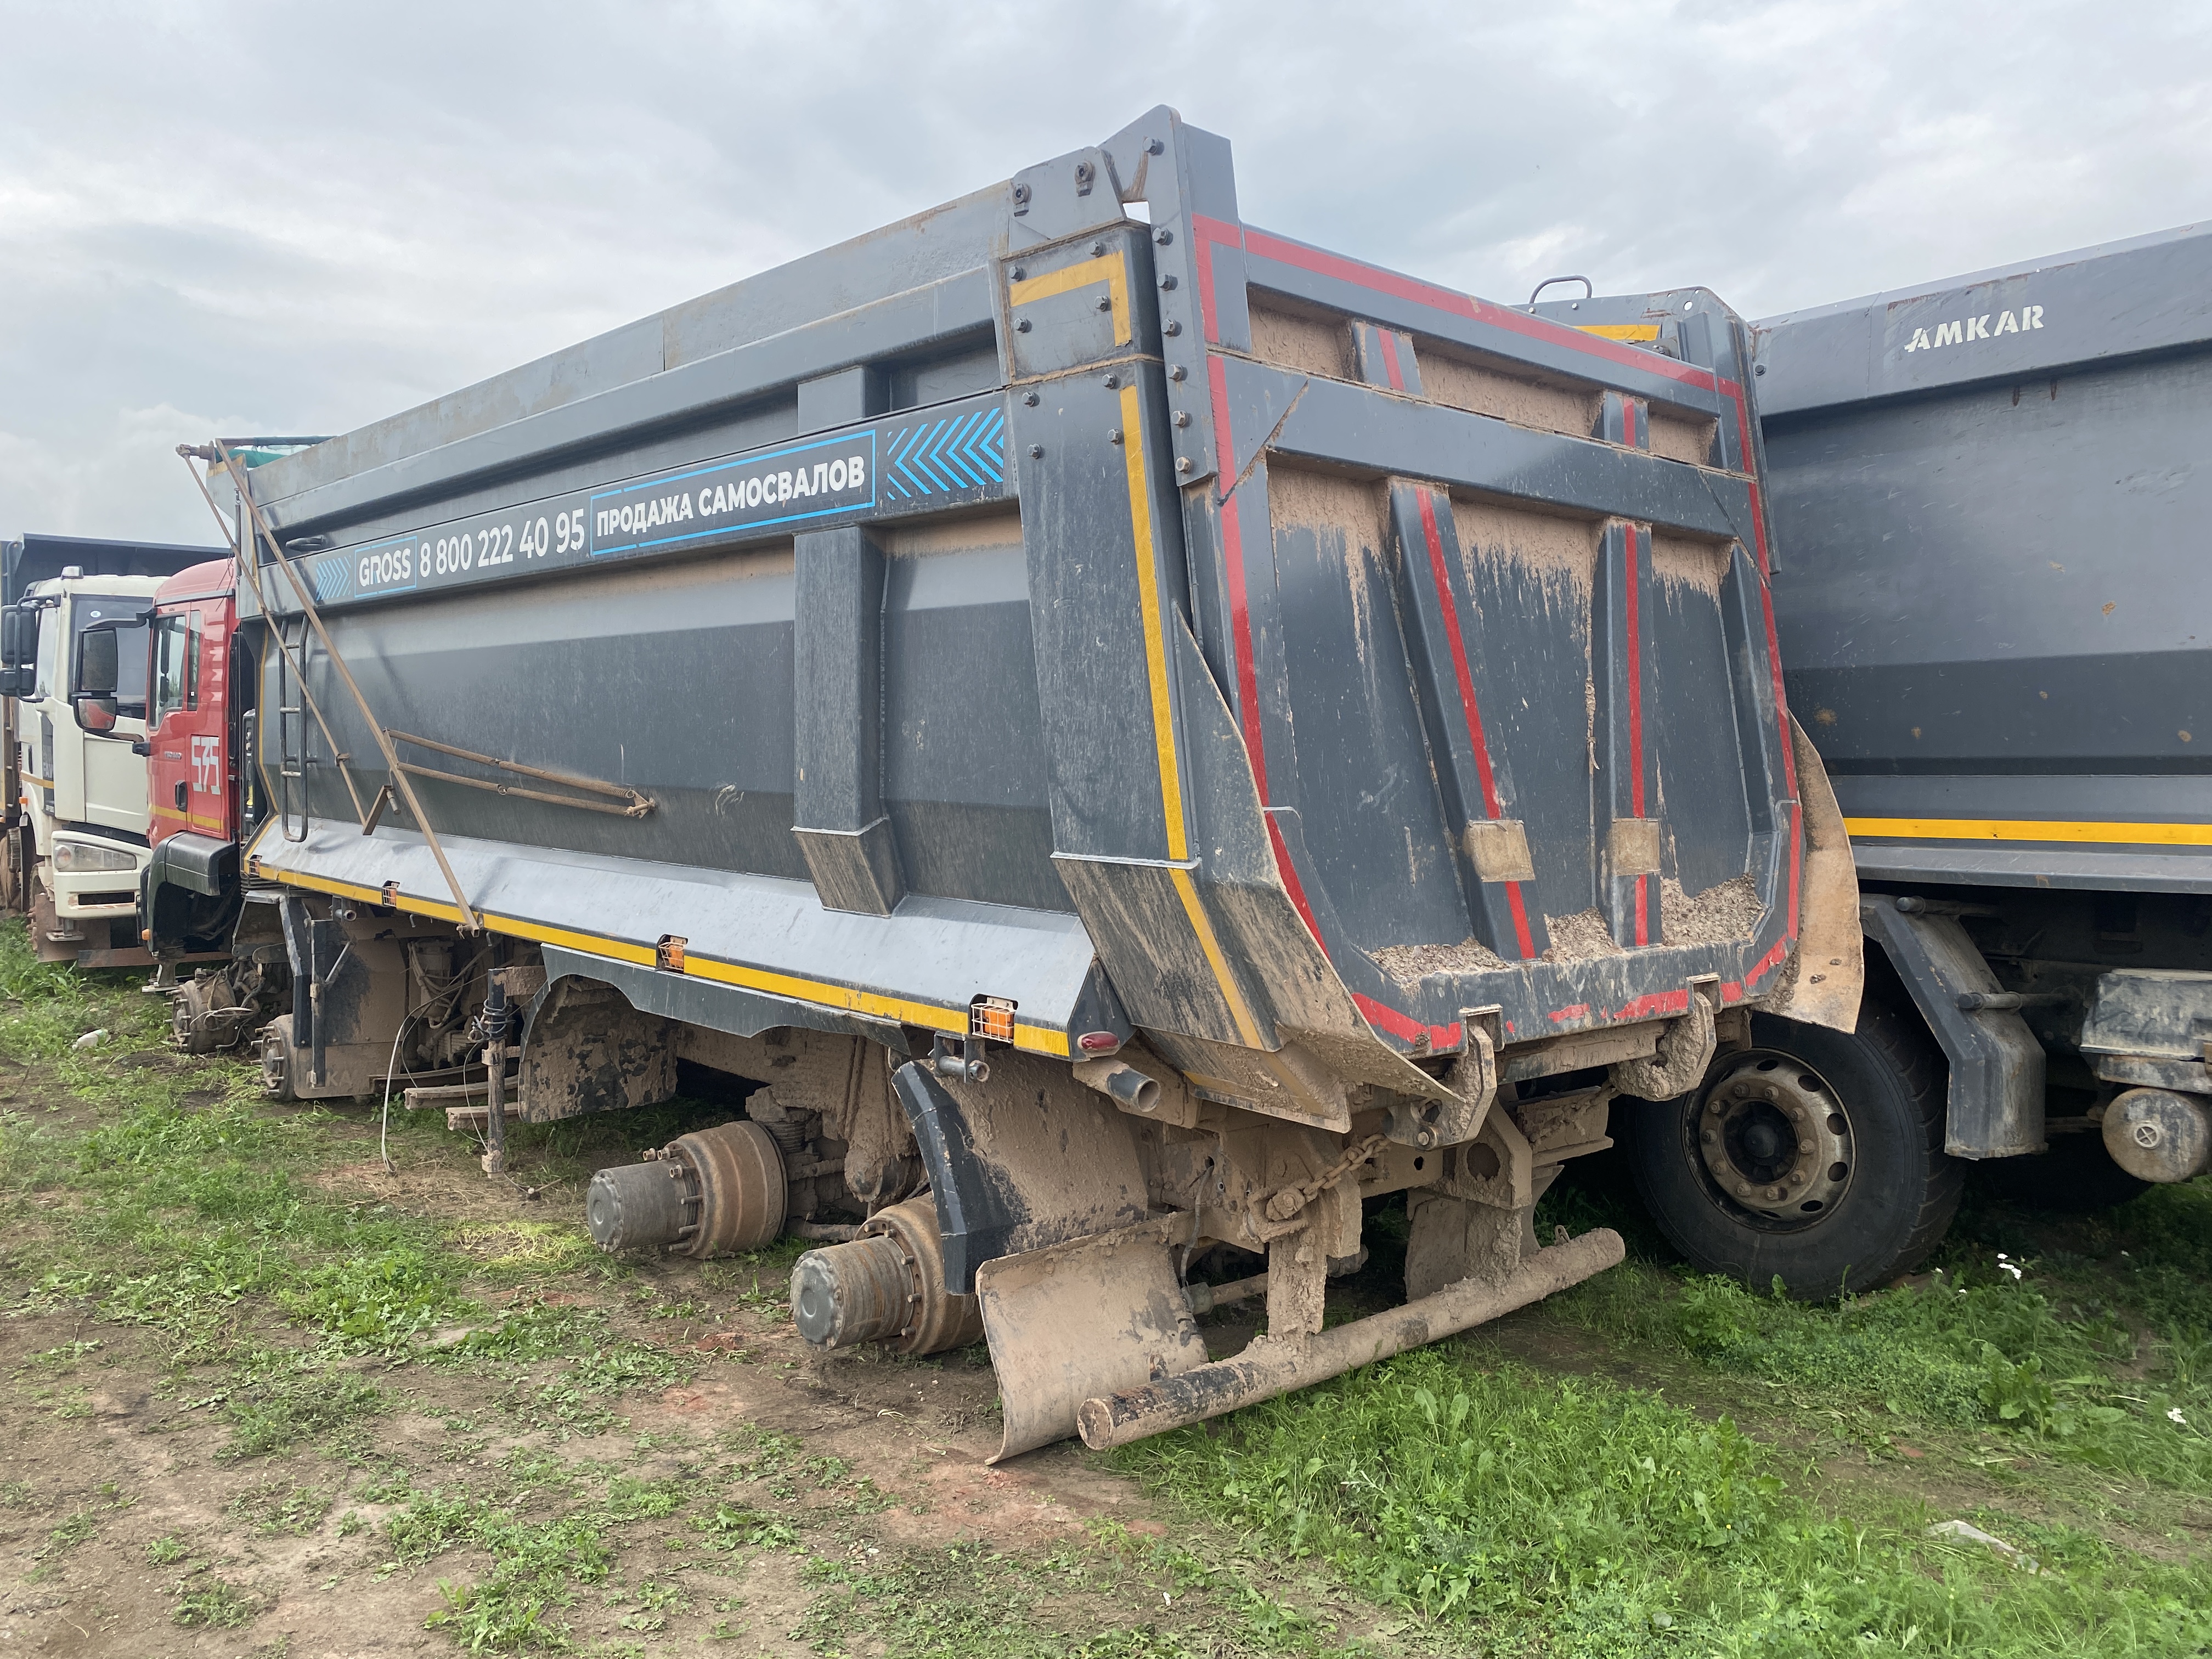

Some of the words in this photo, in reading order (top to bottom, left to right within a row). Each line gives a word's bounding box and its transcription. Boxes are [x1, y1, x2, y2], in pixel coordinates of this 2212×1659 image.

[1904, 305, 2044, 353] AMKAR
[597, 493, 693, 537] ПРОДАЖА
[698, 456, 865, 517] САМОСВАЛОВ
[359, 548, 411, 586] GROSS
[420, 542, 431, 577] 8
[436, 533, 472, 575] 800
[477, 524, 514, 567] 222
[519, 517, 549, 559] 40
[556, 508, 585, 554] 95
